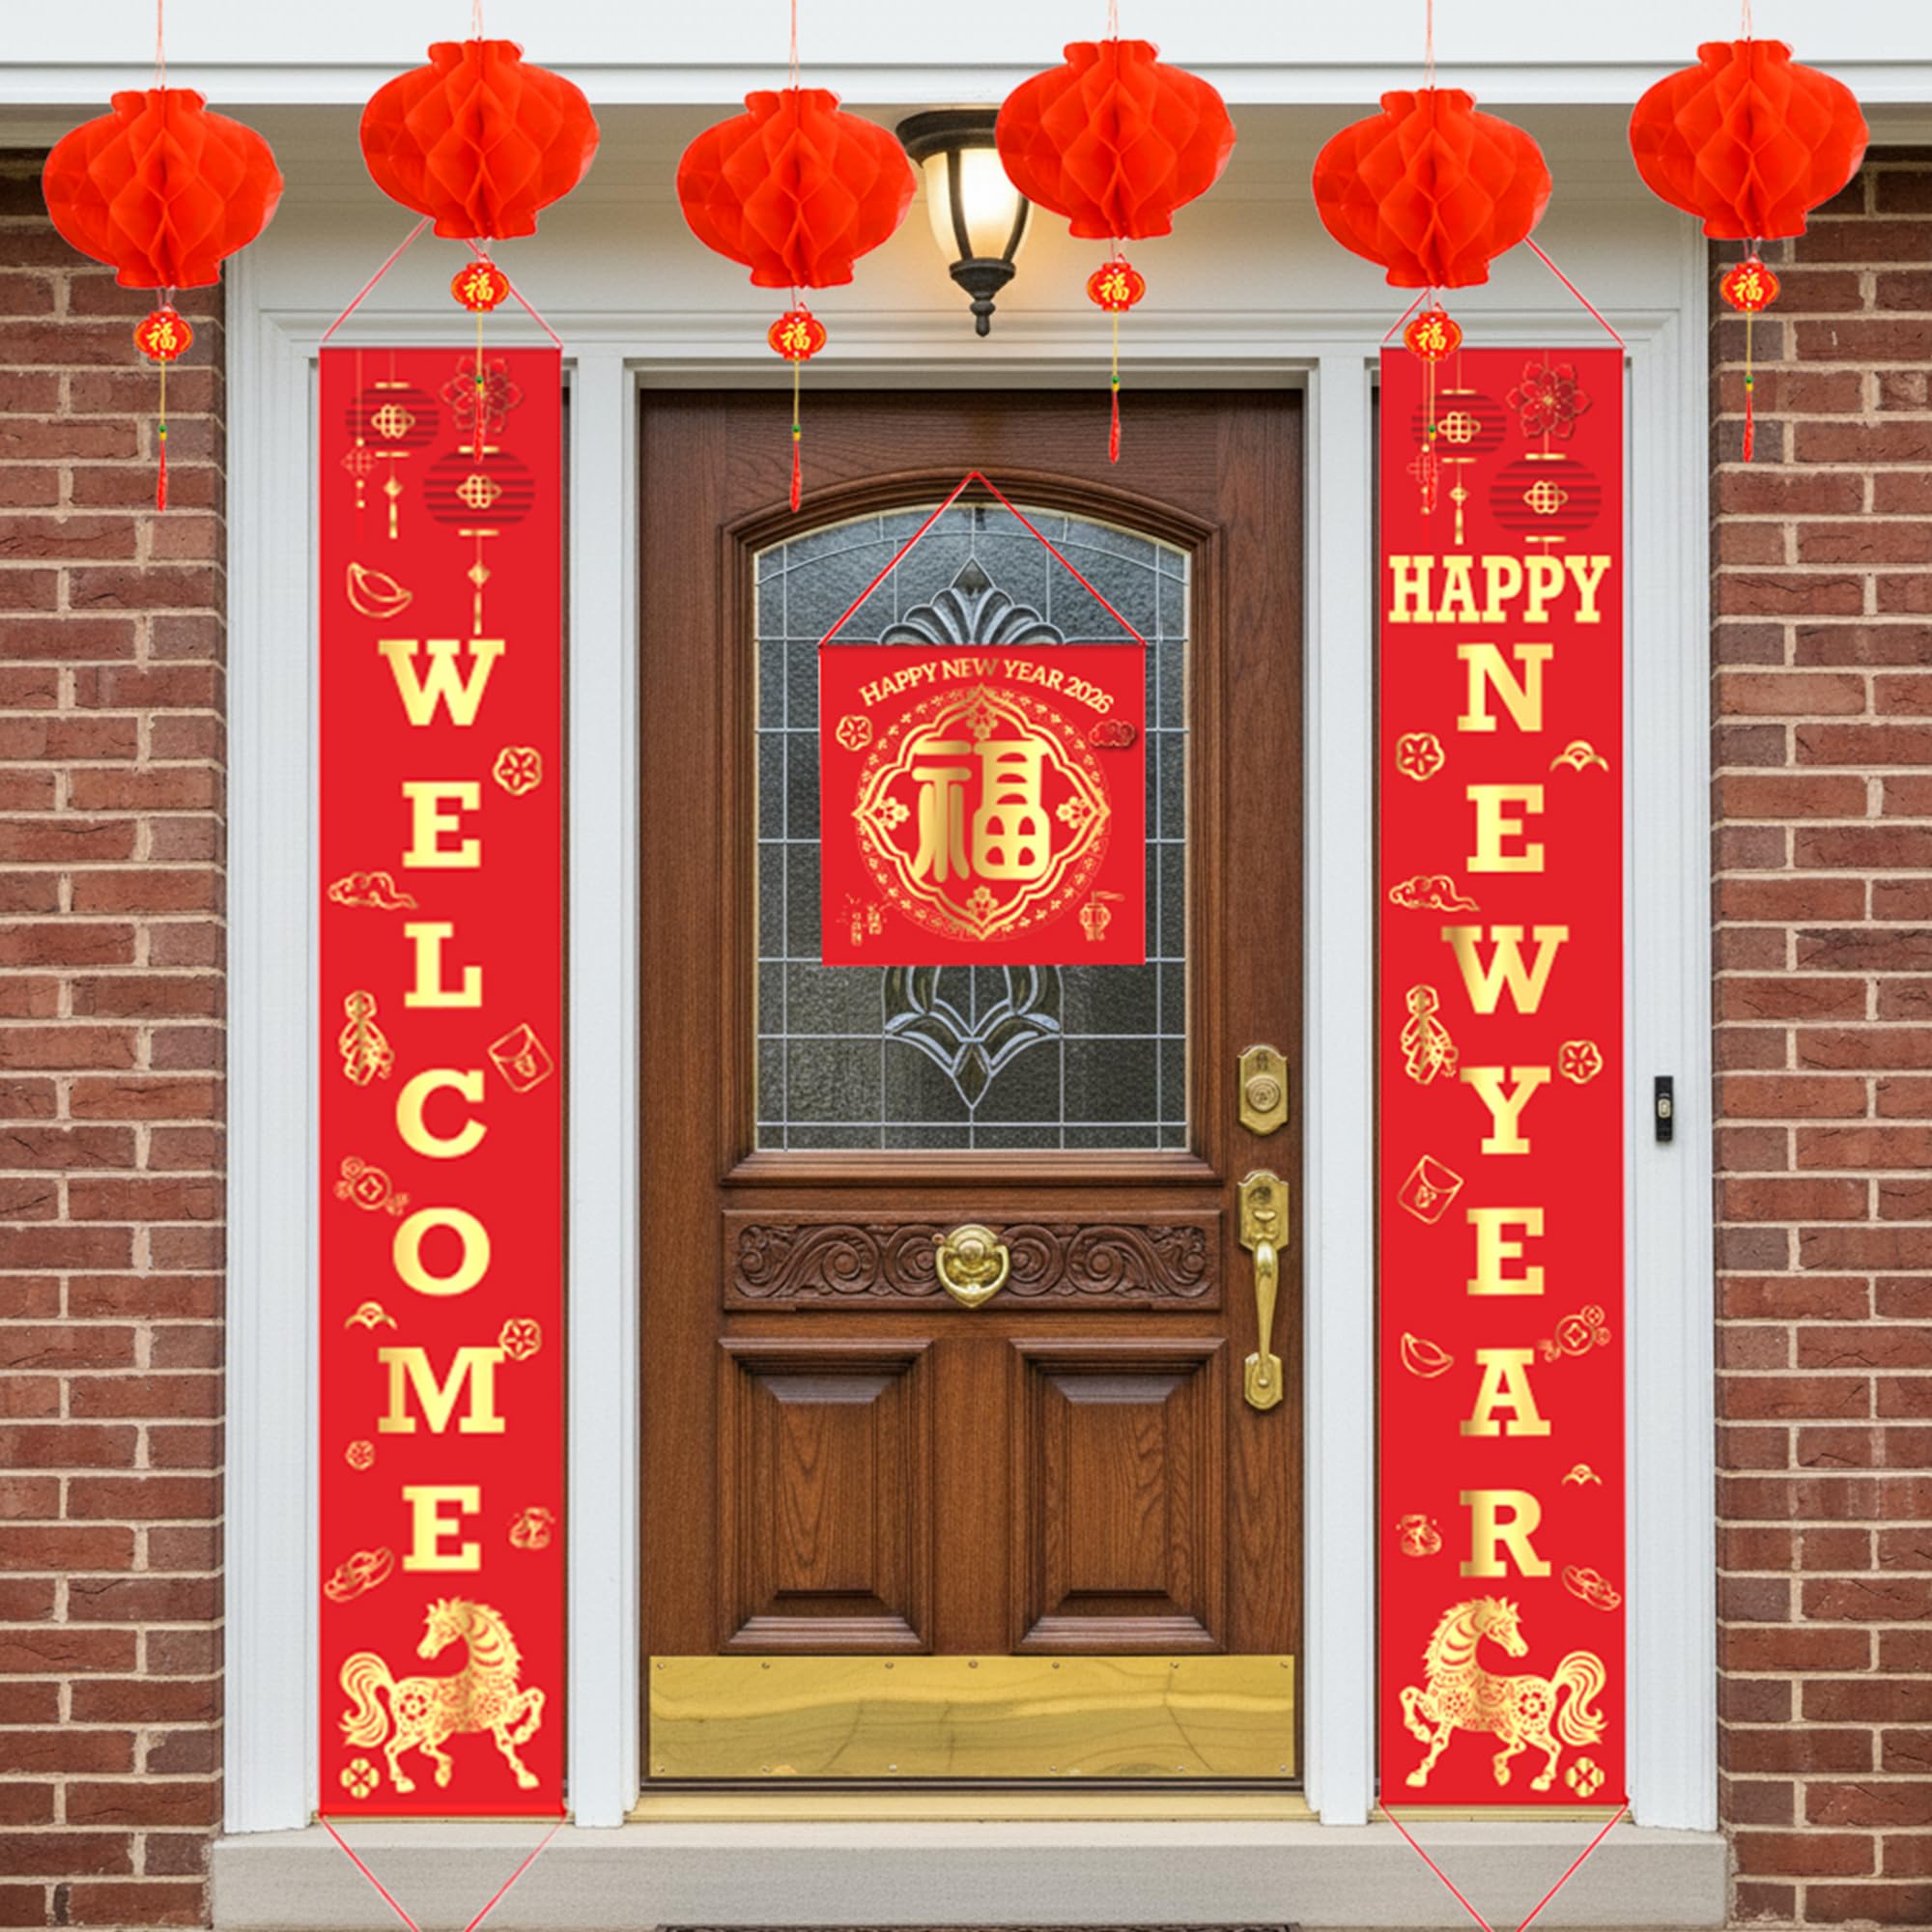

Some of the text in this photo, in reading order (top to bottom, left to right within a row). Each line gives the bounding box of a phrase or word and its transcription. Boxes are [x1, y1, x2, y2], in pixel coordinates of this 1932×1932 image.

[464, 273, 494, 301] 福
[1099, 273, 1129, 301] 福
[1733, 273, 1763, 301] 福
[147, 322, 177, 351] 福
[780, 322, 810, 351] 福
[1416, 322, 1446, 351] 福
[1389, 555, 1611, 623] HAPPY
[858, 658, 1114, 714] HAPPY NEW YEAR 2026
[912, 740, 1050, 883] 福
[378, 639, 506, 1573] WELCOME
